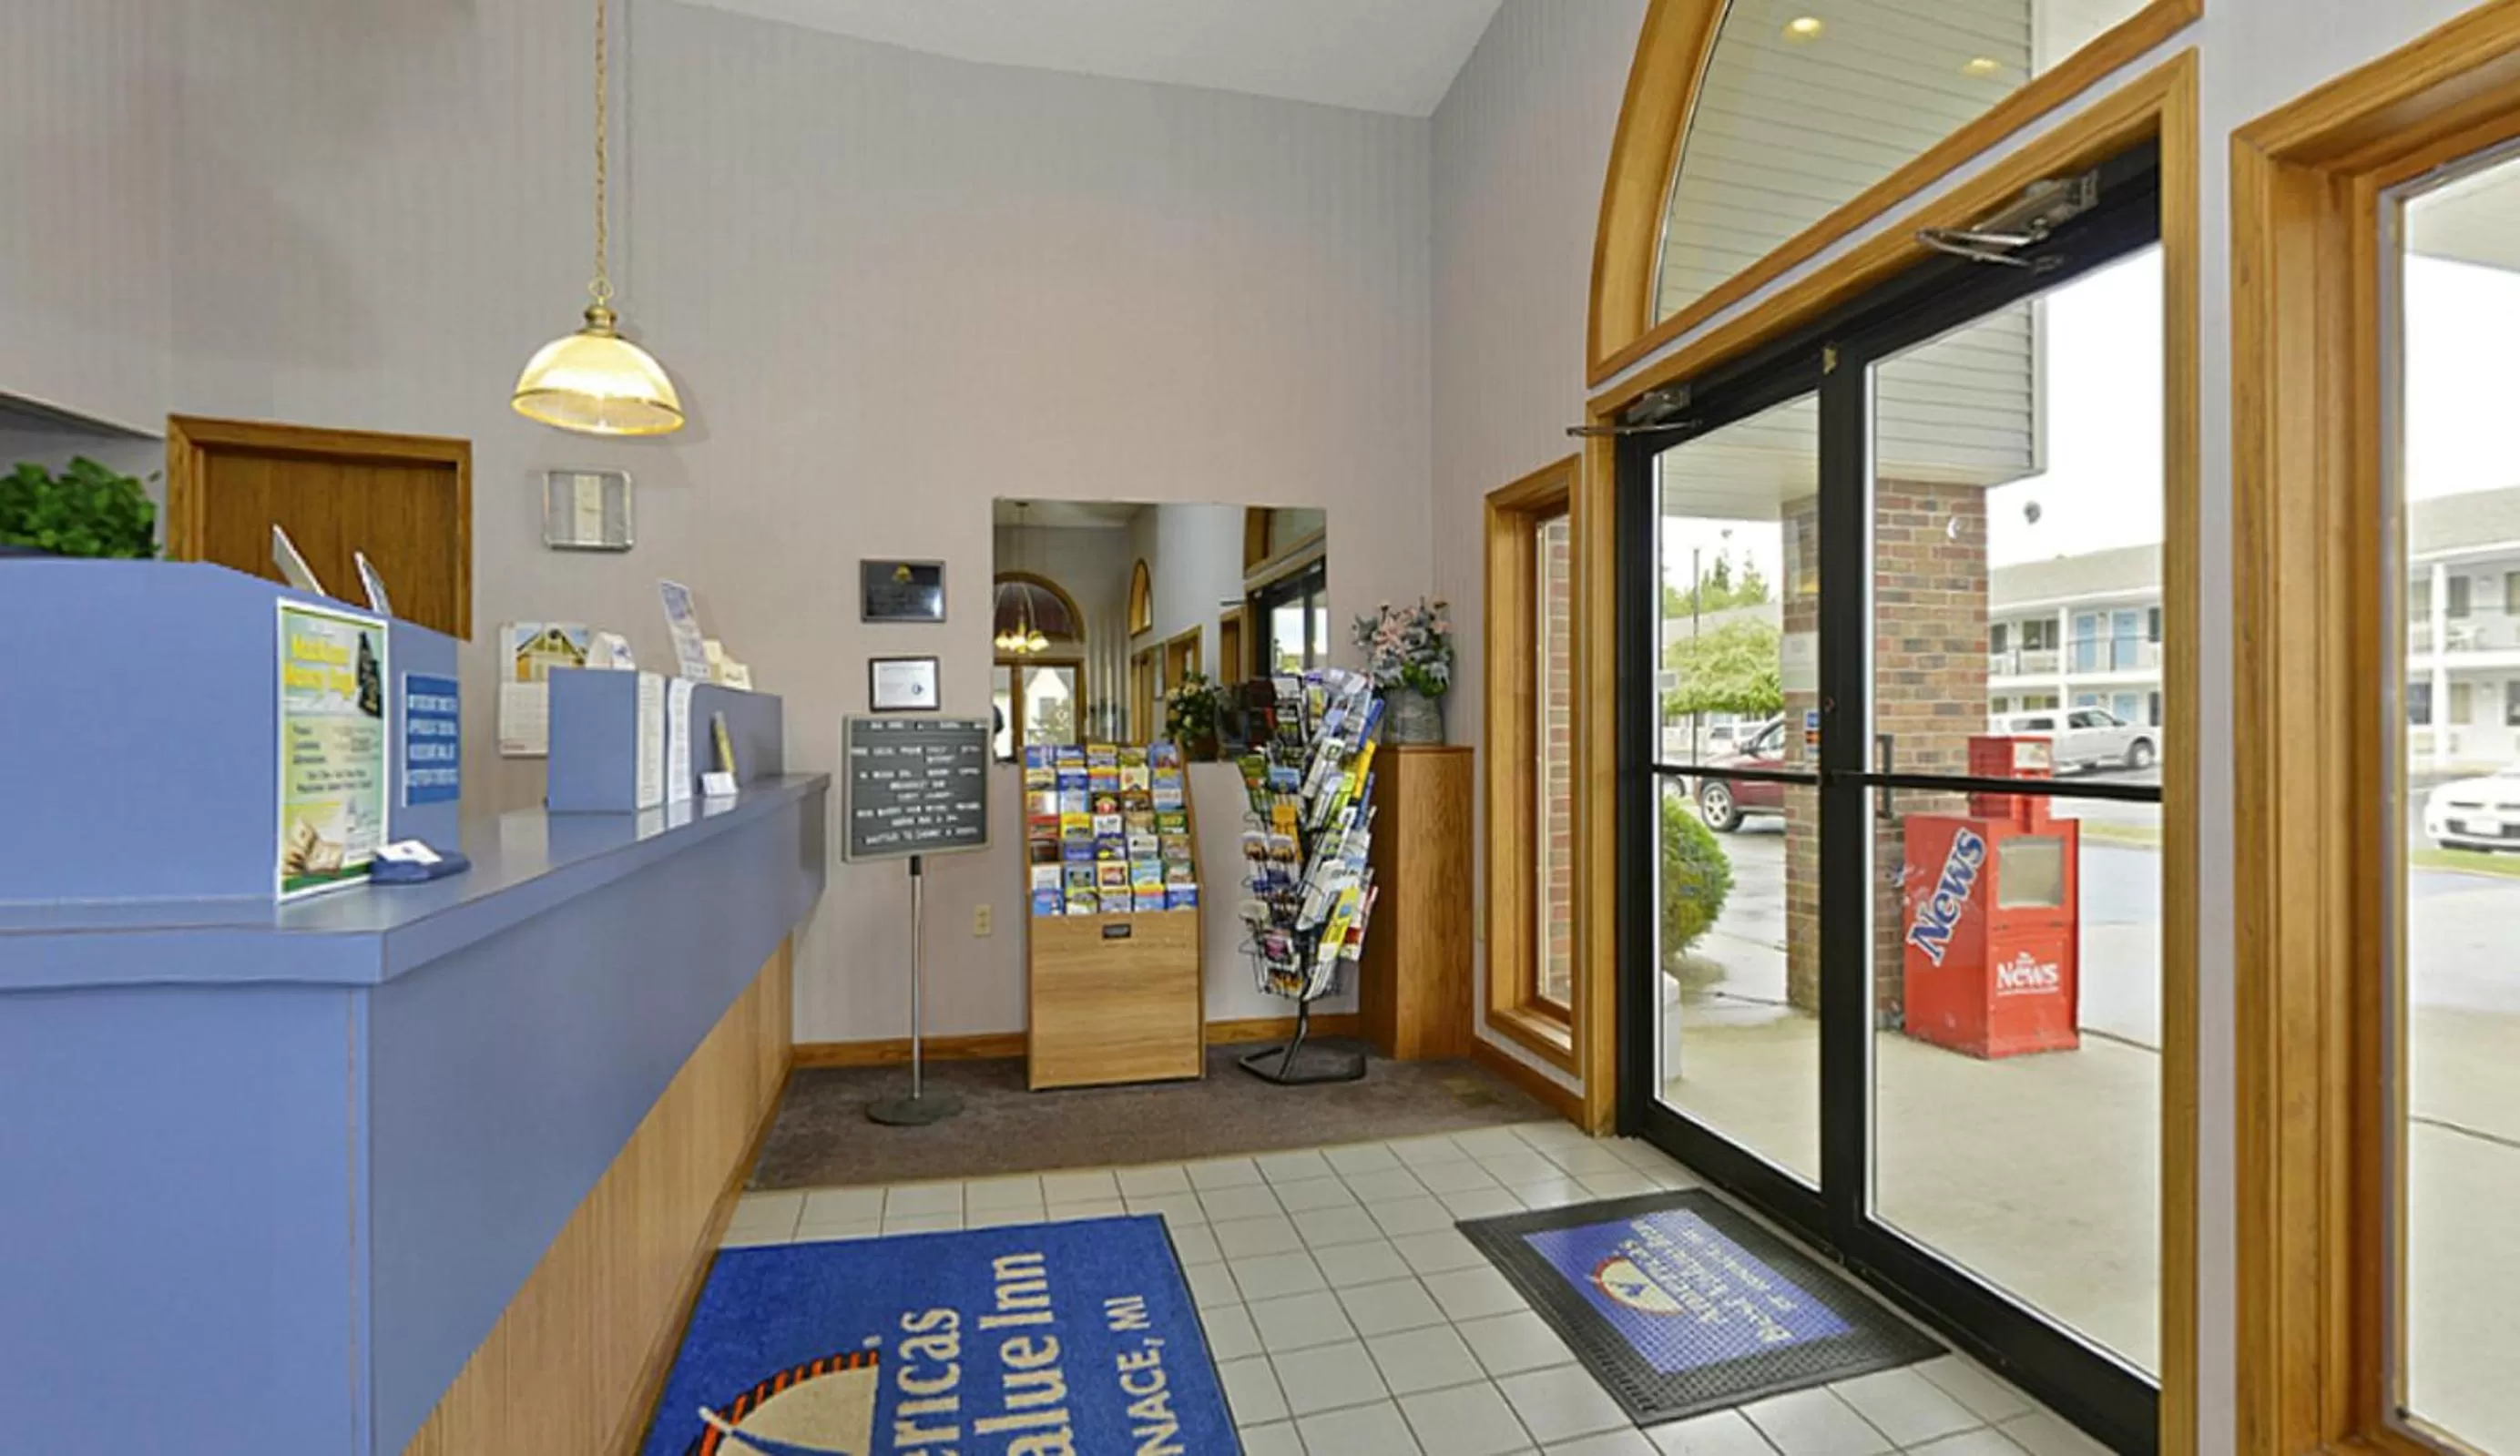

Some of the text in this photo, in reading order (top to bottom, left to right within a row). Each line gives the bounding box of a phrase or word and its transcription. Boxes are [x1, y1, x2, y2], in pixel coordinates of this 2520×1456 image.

[1906, 827, 1986, 966] News
[979, 1253, 1054, 1330] Inn
[1103, 1295, 1151, 1332] MI
[893, 1308, 961, 1456] ricas
